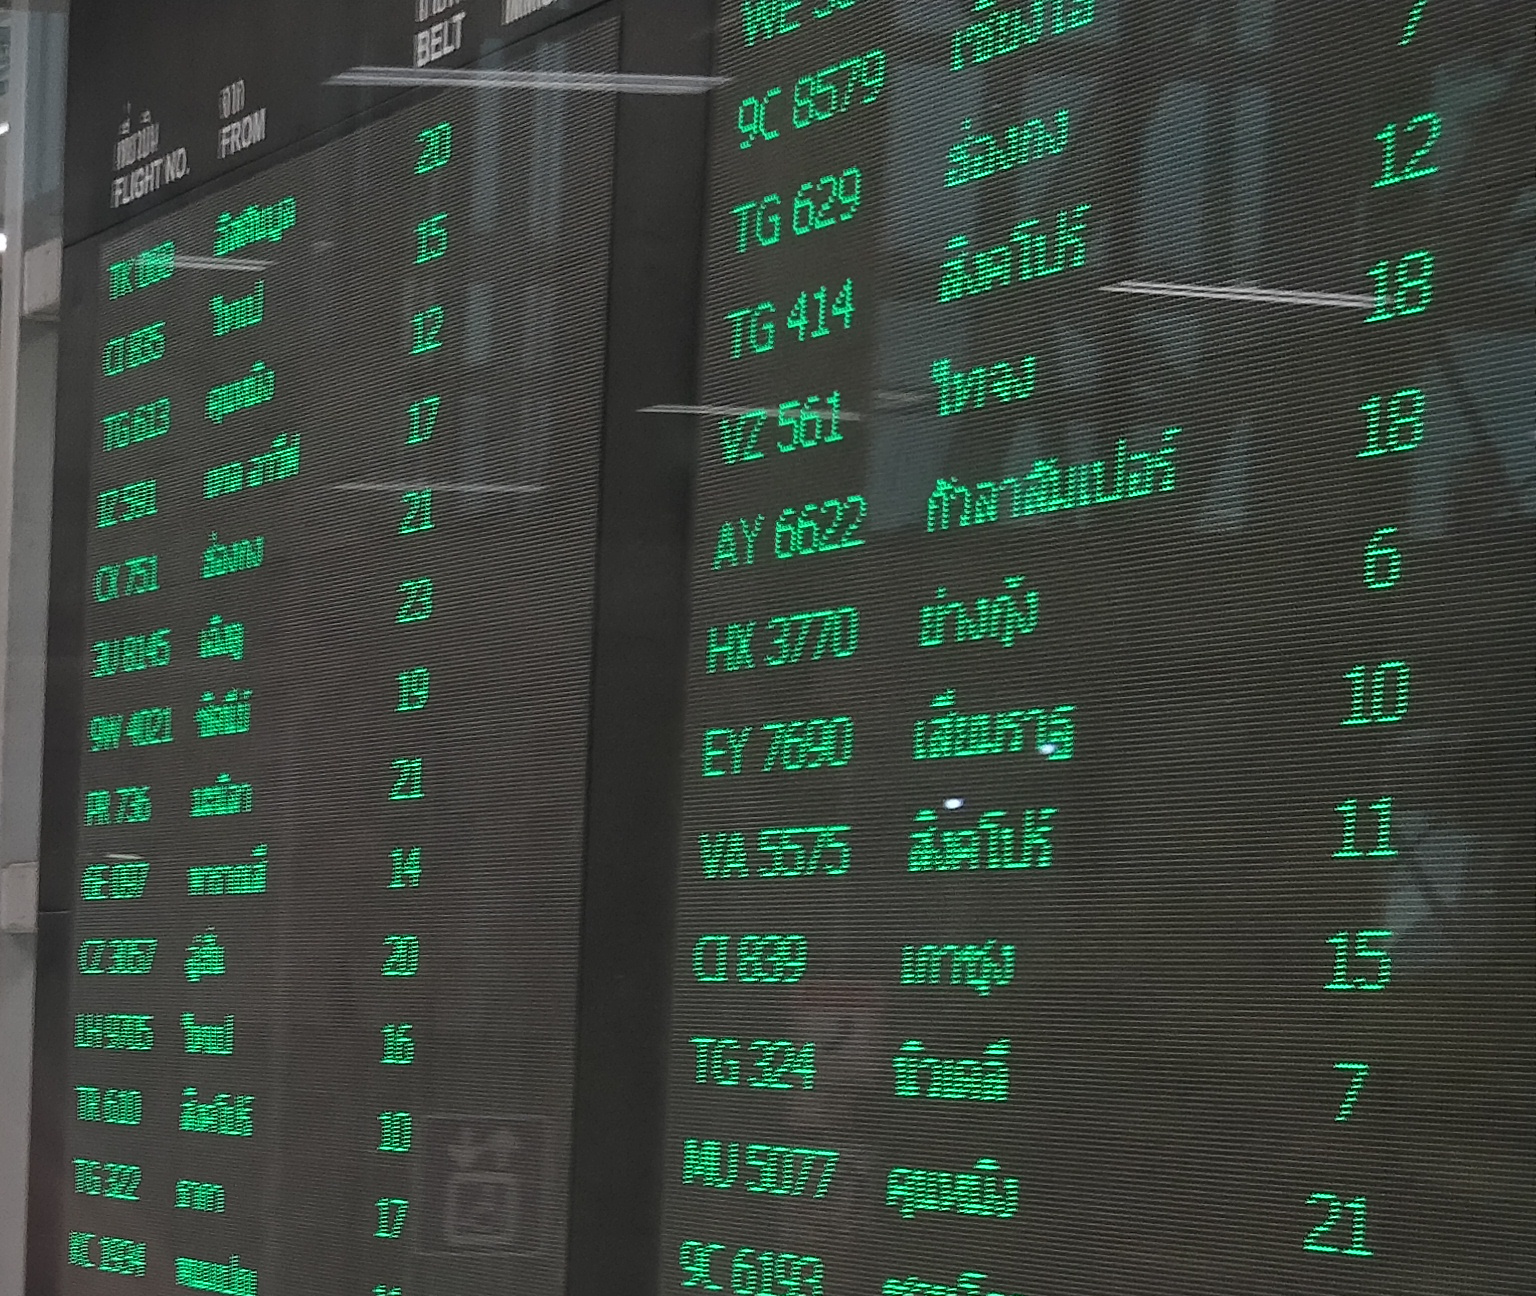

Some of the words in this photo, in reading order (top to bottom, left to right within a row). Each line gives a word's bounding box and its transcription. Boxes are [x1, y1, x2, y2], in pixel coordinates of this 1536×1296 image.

[413, 10, 466, 67] BELT
[737, 87, 782, 149] 9C
[792, 49, 886, 129] 8579
[218, 107, 266, 158] FROM
[415, 122, 452, 174] 20
[945, 109, 1069, 187] ฮ่องกง
[1373, 112, 1442, 187] 12
[111, 157, 164, 209] FLIGHT
[164, 147, 191, 184] NO.
[732, 193, 781, 253] TG
[792, 167, 862, 235] 629
[415, 212, 447, 264] 15
[939, 204, 1091, 302] สิงคโปร์
[1365, 250, 1434, 322] 18
[411, 305, 443, 355] 12
[726, 301, 776, 358] TG
[787, 278, 856, 341] 414
[105, 337, 126, 376] CI
[103, 411, 130, 449] TG
[130, 397, 171, 443] 613
[407, 395, 440, 444] 17
[721, 408, 768, 464] VZ
[777, 391, 843, 453] 561
[1357, 389, 1425, 457] 18
[399, 489, 433, 534] 21
[713, 514, 764, 569] AY
[775, 495, 868, 560] 6622
[96, 565, 120, 602] CX
[123, 555, 159, 594] 751
[1364, 527, 1401, 588] 6
[397, 577, 433, 623] 23
[919, 575, 1039, 647] ย่างกุ้ง
[92, 641, 120, 677] 3U
[120, 628, 171, 672] 8145
[707, 622, 756, 672] HX
[765, 606, 859, 666] 3770
[397, 667, 429, 711] 19
[1341, 661, 1409, 725] 10
[90, 716, 123, 751] 9W
[702, 727, 751, 776] EY
[762, 716, 853, 771] 7690
[390, 758, 424, 799] 21
[86, 790, 111, 824] PR
[1333, 797, 1398, 857] 11
[700, 832, 748, 878] VA
[758, 824, 851, 877] 5575
[908, 808, 1057, 871] สิงคโปร์
[389, 848, 421, 888] 14
[80, 938, 106, 973] CZ
[383, 934, 418, 976] 20
[693, 934, 730, 981] CI
[737, 934, 807, 982] 839
[1324, 930, 1393, 990] 15
[76, 1015, 103, 1047] LH
[381, 1023, 414, 1064] 16
[690, 1037, 740, 1085] TG
[747, 1040, 815, 1089] 324
[76, 1087, 100, 1121] TR
[103, 1090, 141, 1124] 610
[1335, 1063, 1369, 1120] 7
[379, 1112, 411, 1151] 10
[74, 1159, 101, 1195] TG
[104, 1163, 140, 1200] 322
[683, 1139, 738, 1188] MU
[746, 1144, 838, 1197] 5077
[375, 1198, 408, 1238] 17
[1304, 1193, 1373, 1256] 21
[70, 1232, 94, 1267] KC
[680, 1241, 725, 1290] 9C
